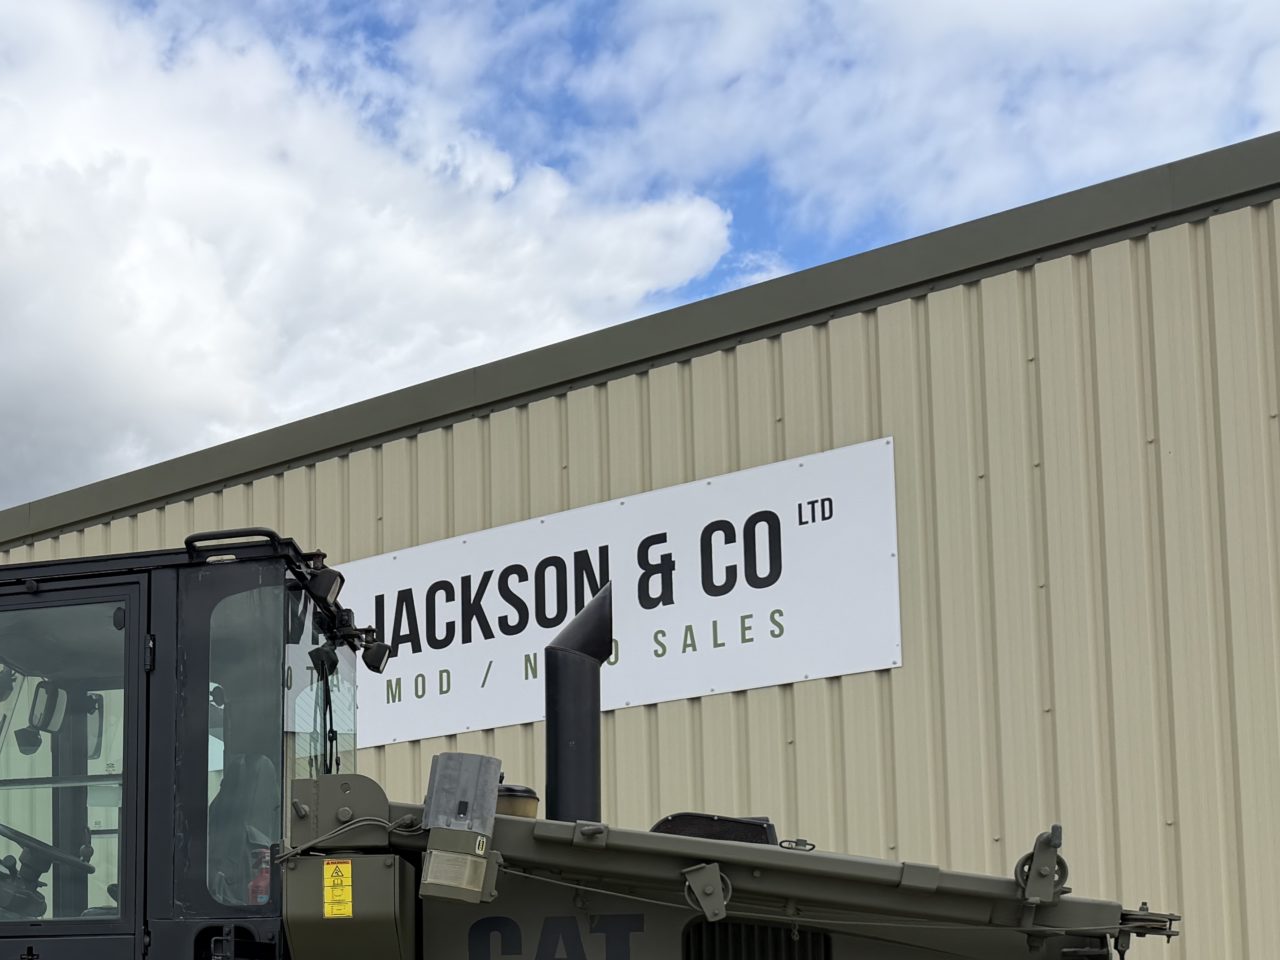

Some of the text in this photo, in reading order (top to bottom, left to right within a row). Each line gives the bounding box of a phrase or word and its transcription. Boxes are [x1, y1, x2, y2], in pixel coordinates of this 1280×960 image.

[375, 544, 610, 659] JACKSON
[637, 532, 676, 610] &
[700, 510, 783, 597] CO
[797, 497, 834, 526] LTD
[386, 609, 785, 704] MOD / NO SALES
